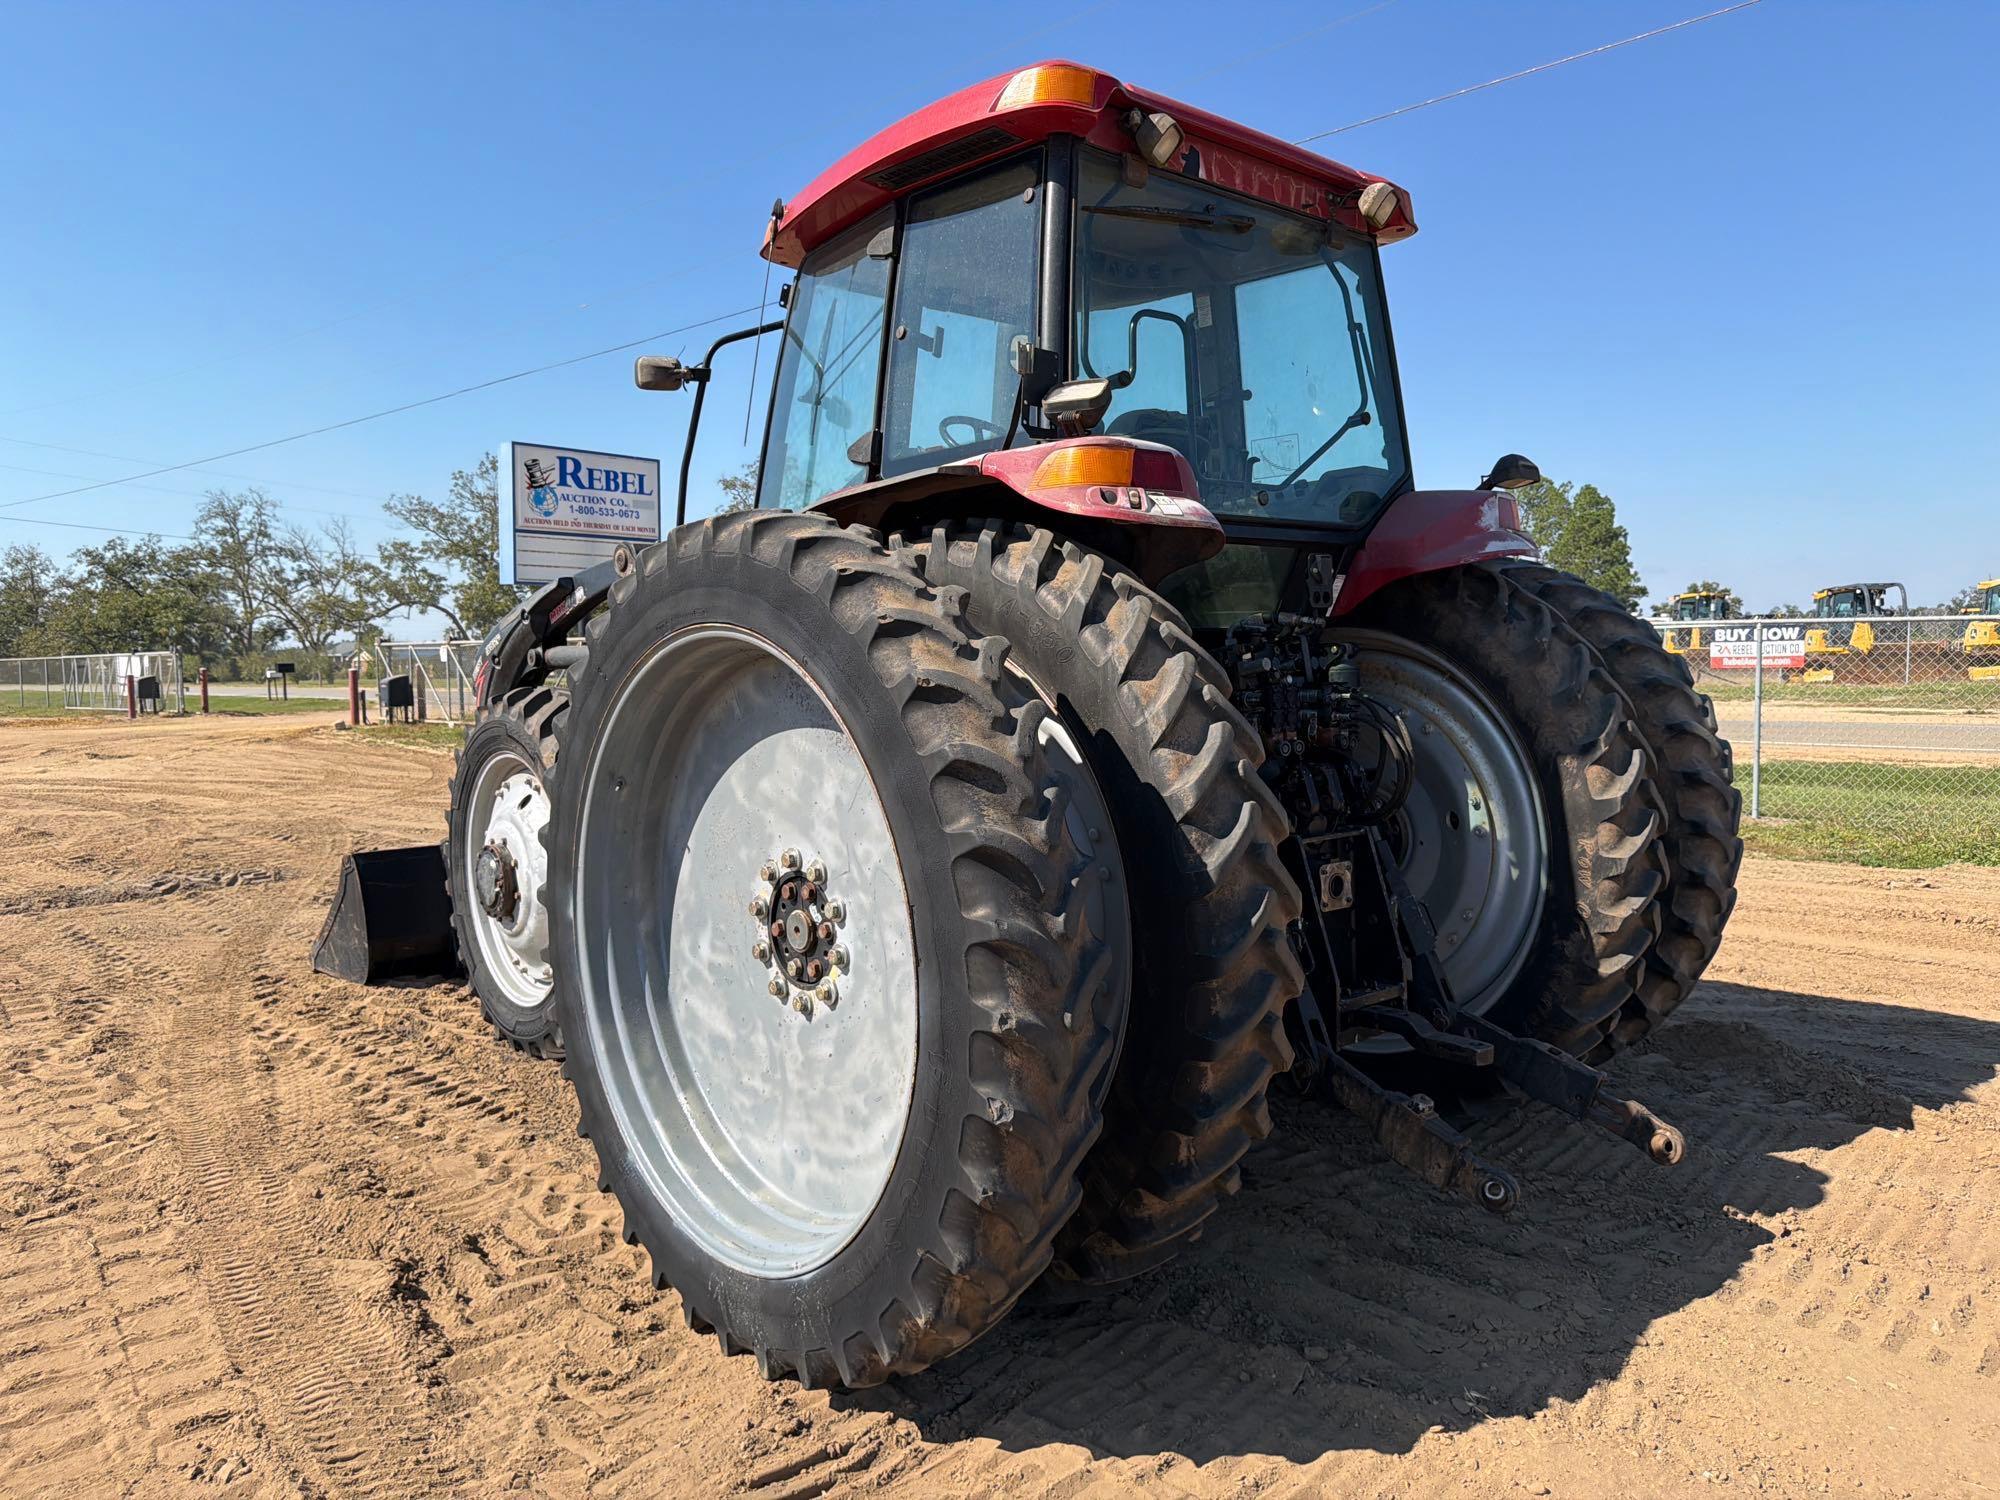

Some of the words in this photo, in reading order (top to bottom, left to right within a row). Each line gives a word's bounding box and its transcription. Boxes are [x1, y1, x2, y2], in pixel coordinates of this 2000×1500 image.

[556, 456, 653, 496] REBEL
[560, 493, 606, 505] AUCTION
[570, 505, 640, 519] 1-800-533-0673
[524, 517, 552, 525] AUCTIONS
[554, 519, 569, 527] HELD
[583, 522, 611, 530] THURSDAY
[637, 526, 656, 534] MONTH
[1715, 628, 1750, 642] BUY
[1732, 644, 1753, 655] REBEL
[1757, 643, 1787, 655] UCTION
